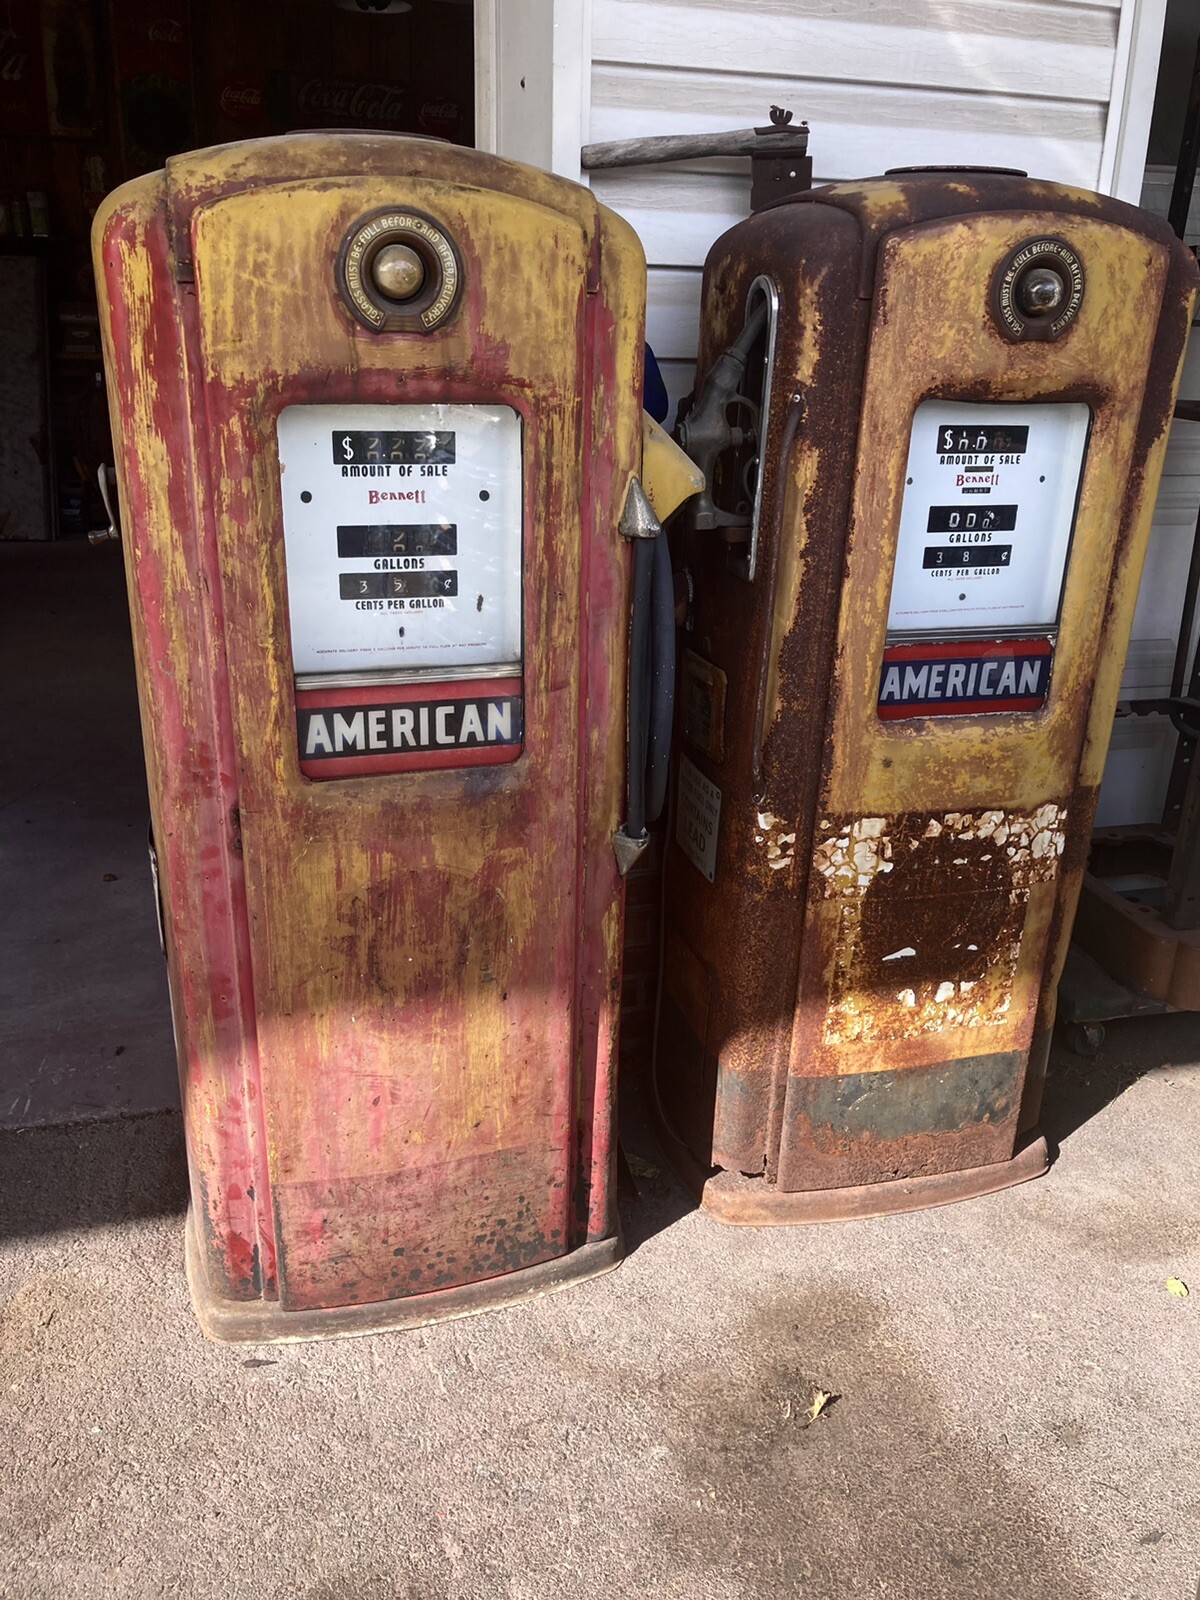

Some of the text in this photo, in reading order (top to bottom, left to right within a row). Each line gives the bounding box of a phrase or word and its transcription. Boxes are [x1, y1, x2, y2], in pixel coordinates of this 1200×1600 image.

[298, 79, 406, 119] Coca-Cola
[348, 216, 455, 321] GLASS MUST BE FULL BEFORE AND AFTER DELIVERY
[1002, 243, 1081, 331] GLASS MUST BE FULL BEFORE AND AFTER DELIVERY
[940, 455, 1021, 465] AMOUNT OF SALE
[342, 465, 448, 477] AMOUNT OF SALE
[956, 474, 999, 486] Bennett
[368, 489, 426, 504] Bennett
[949, 533, 992, 543] GALLONS
[374, 558, 425, 570] GALLONS
[931, 568, 1000, 577] CENTS PER GALLON
[355, 598, 444, 610] CENTS PER GALLON
[880, 661, 1041, 701] AMERICAN
[305, 702, 511, 754] AMERICAN
[684, 816, 706, 852] LEAD
